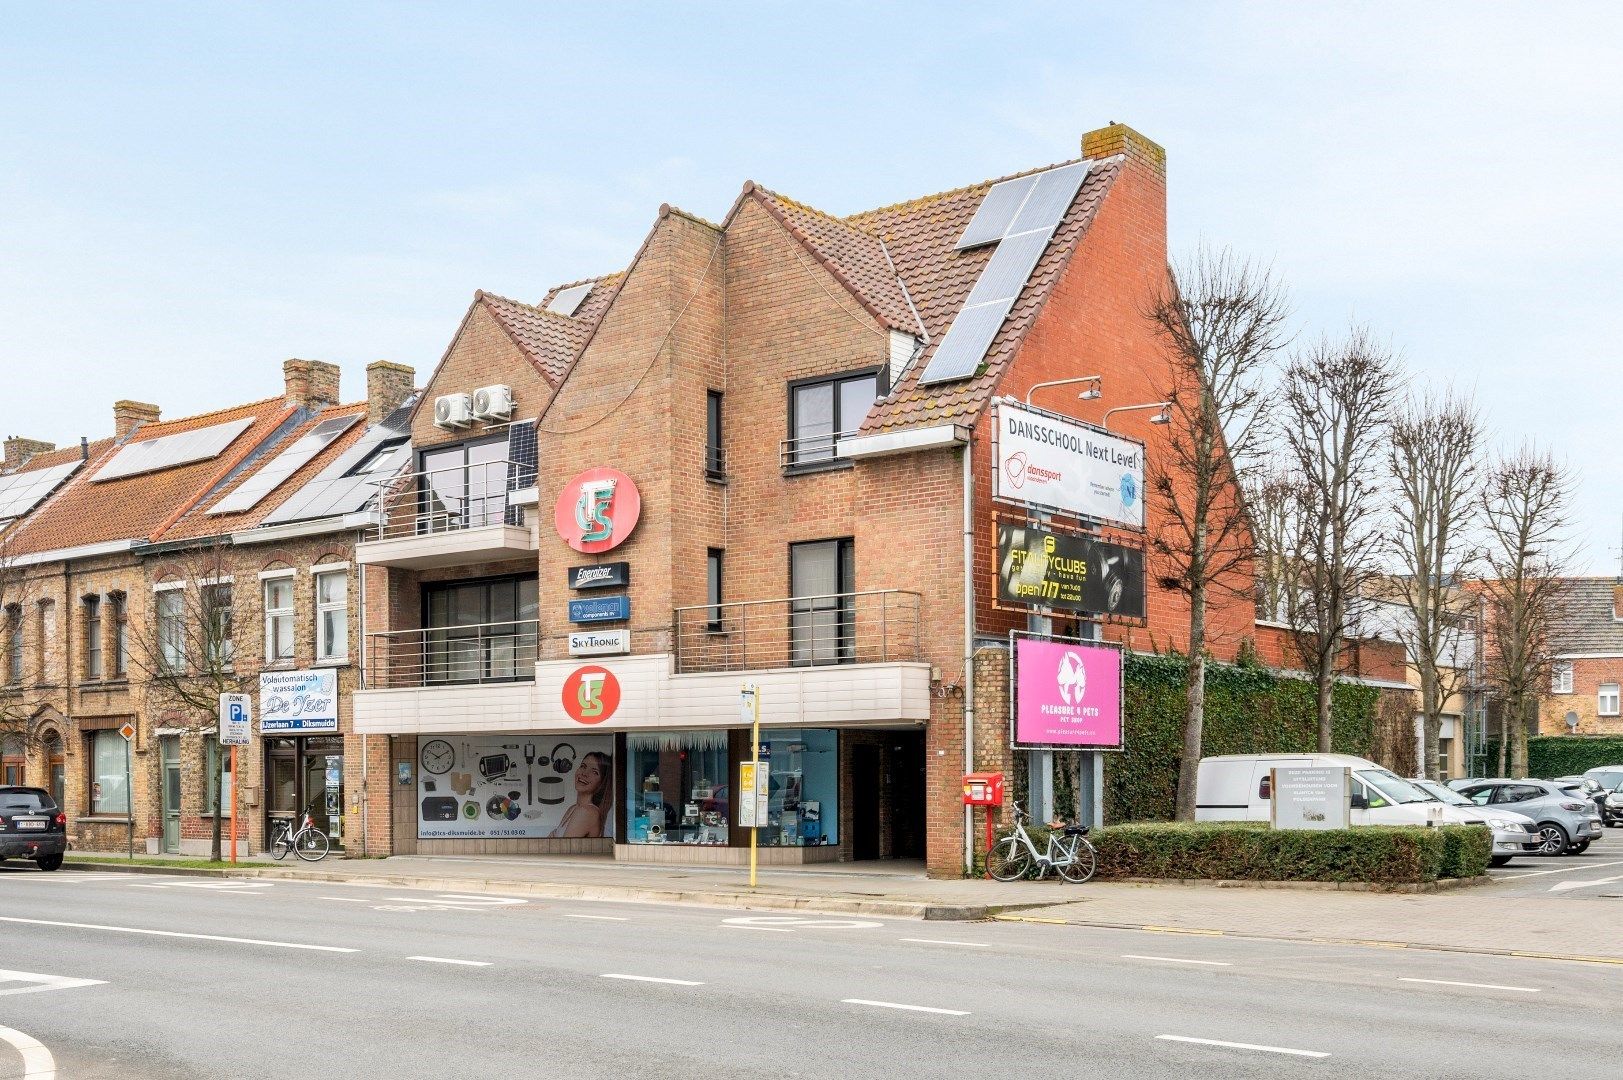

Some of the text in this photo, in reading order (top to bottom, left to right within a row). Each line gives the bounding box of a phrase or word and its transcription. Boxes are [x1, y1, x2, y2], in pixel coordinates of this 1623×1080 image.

[1008, 417, 1137, 470] DANSSCHOOL Next Level
[1027, 464, 1062, 481] danssport
[1011, 550, 1087, 575] FITALITYCLUBS
[577, 566, 612, 580] Energizer
[1015, 580, 1060, 599] open 7/7
[582, 611, 609, 619] components
[262, 673, 318, 684] Volautomatisch
[272, 684, 306, 693] wassalon
[266, 695, 290, 714] De
[1041, 704, 1075, 716] PLEASURE
[1083, 706, 1099, 717] PETS
[232, 705, 241, 720] P
[302, 719, 335, 728] Diksmuide
